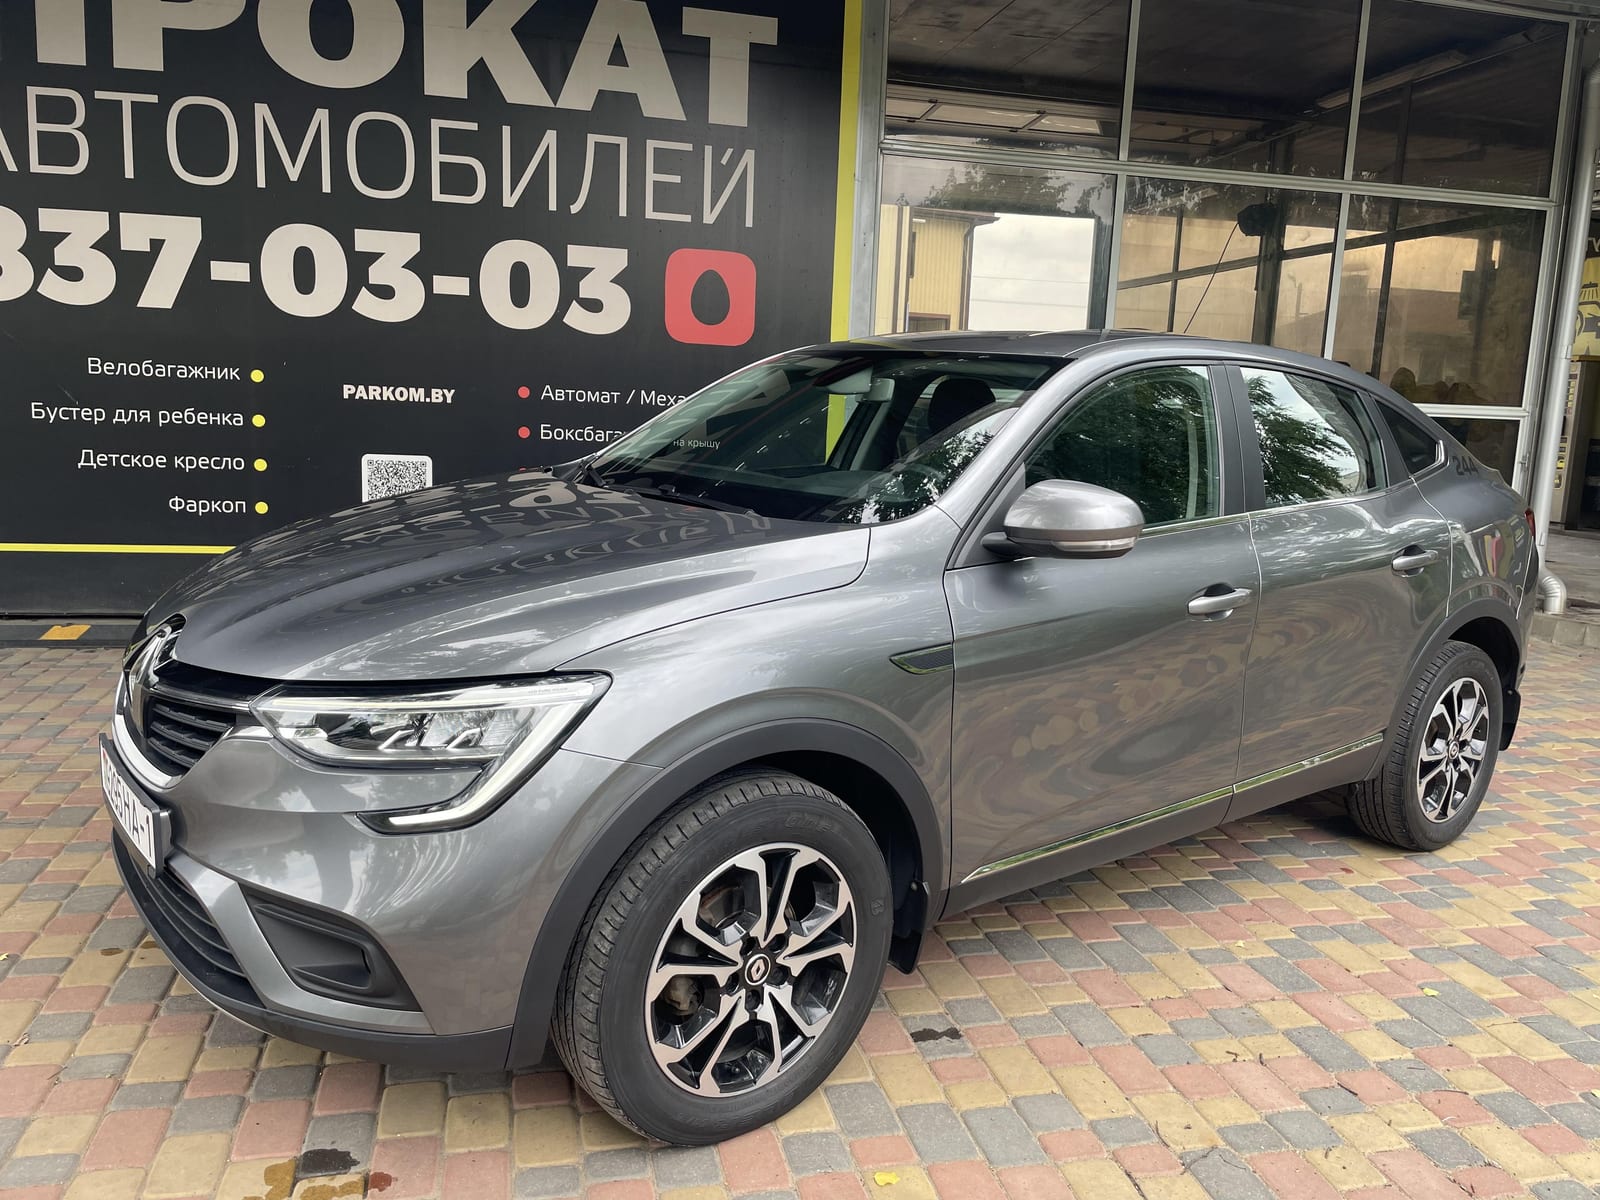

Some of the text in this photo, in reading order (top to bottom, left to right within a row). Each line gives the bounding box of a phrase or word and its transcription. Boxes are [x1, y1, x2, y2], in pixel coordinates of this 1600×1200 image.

[35, 0, 778, 128] РОКАТ
[0, 86, 755, 228] ВТОМОБИЛЕЙ
[87, 357, 241, 381] Велобагажник
[342, 384, 456, 405] PARKOM.BY
[540, 384, 621, 404] Автомат
[31, 402, 244, 427] Бустер для ребенка
[673, 439, 685, 447] на
[687, 440, 721, 451] крышу
[77, 449, 245, 473] Детское кресло
[168, 495, 246, 516] Фаркоп
